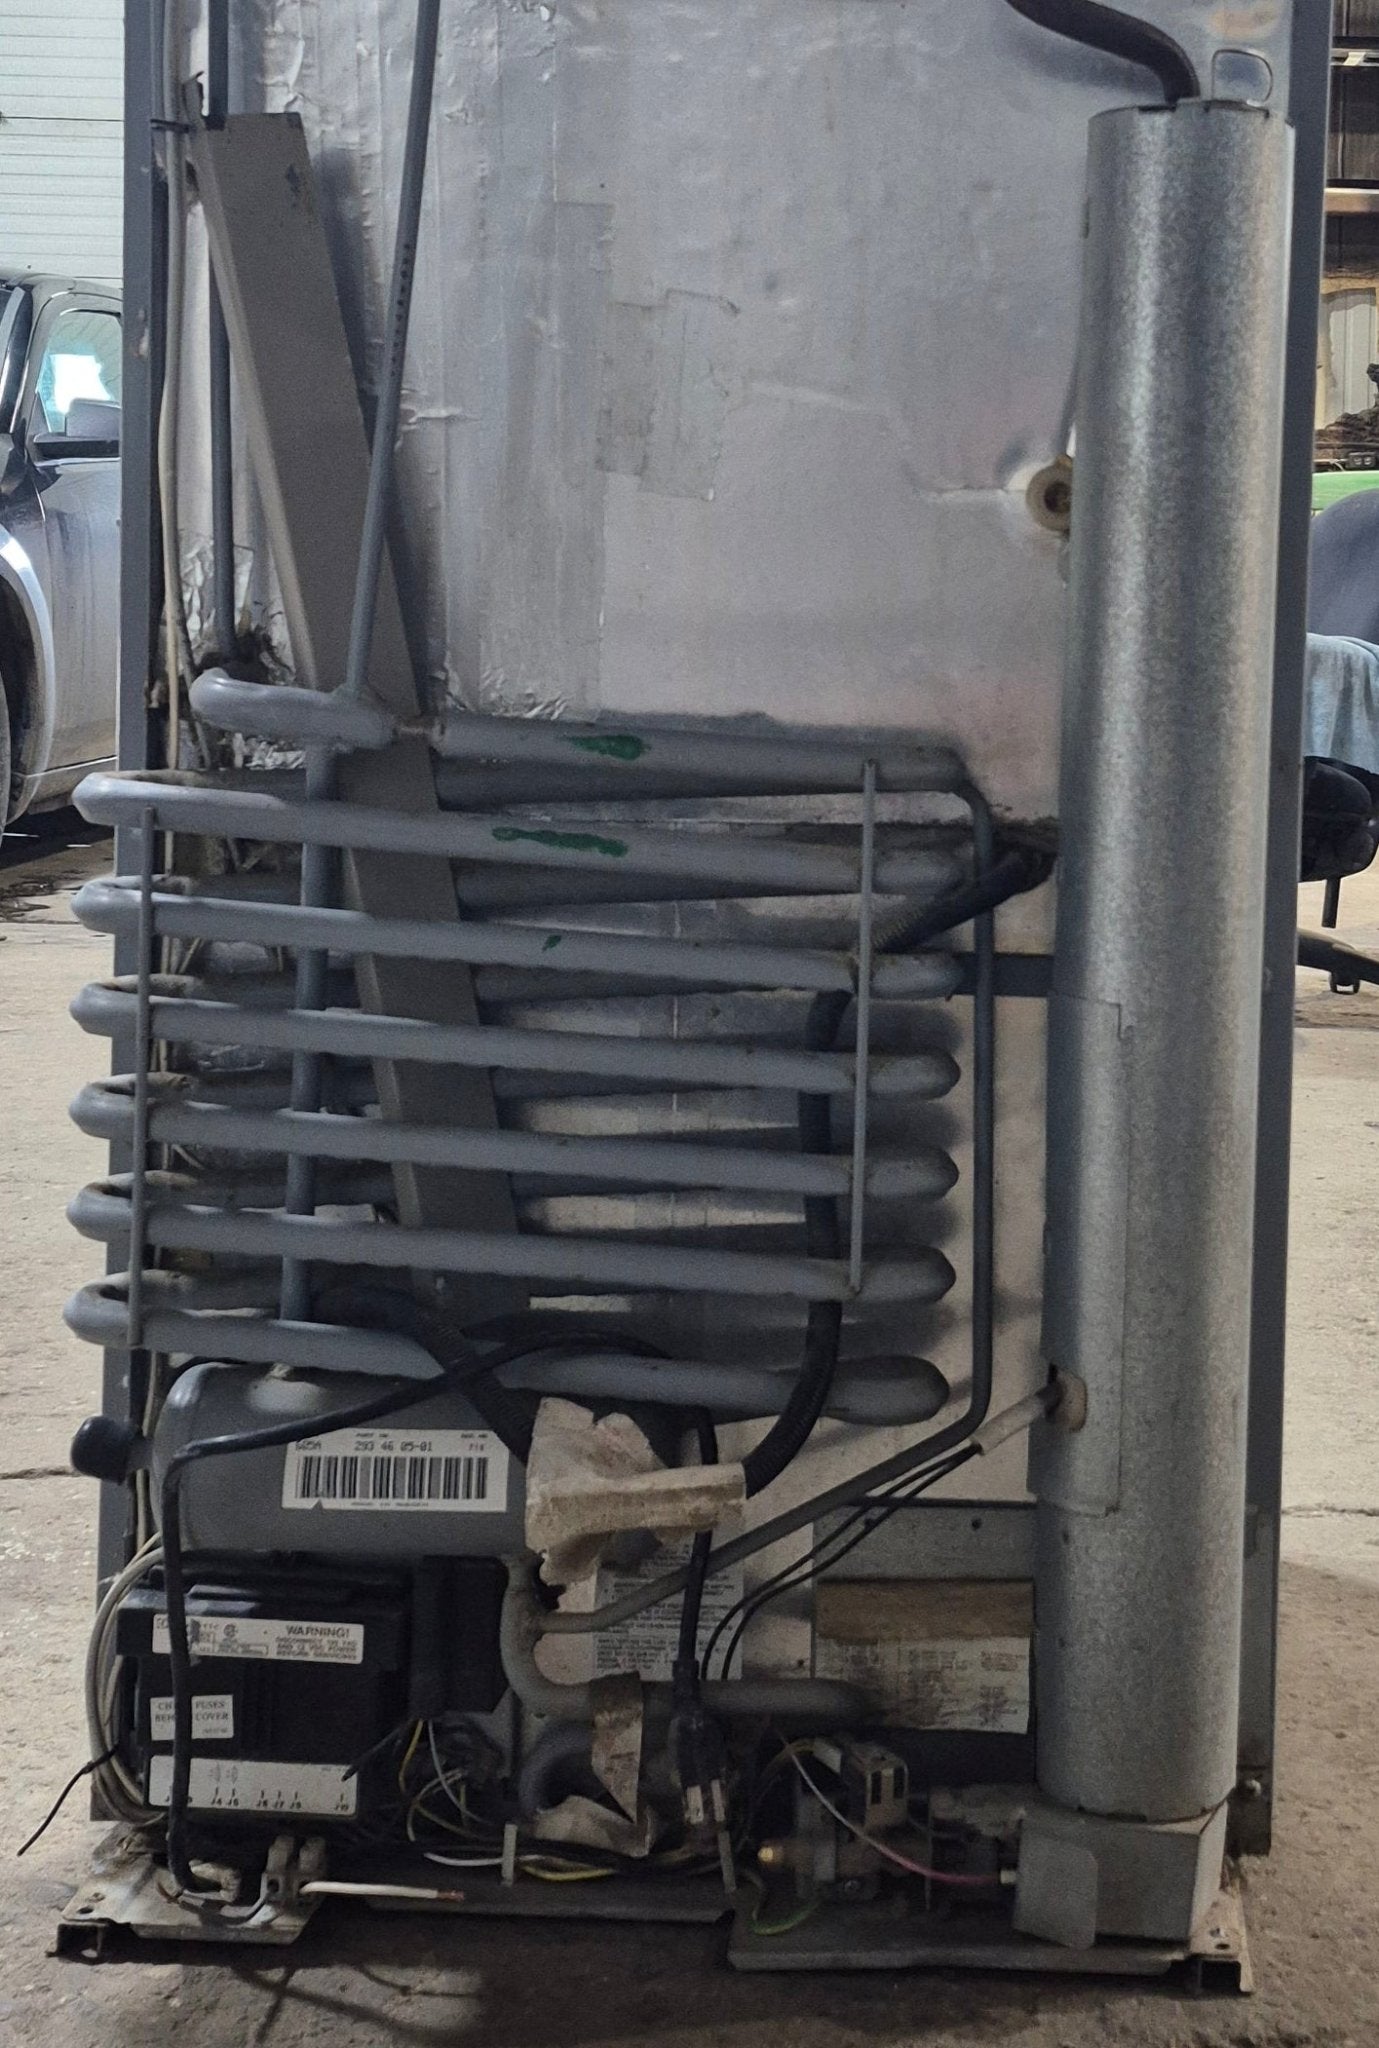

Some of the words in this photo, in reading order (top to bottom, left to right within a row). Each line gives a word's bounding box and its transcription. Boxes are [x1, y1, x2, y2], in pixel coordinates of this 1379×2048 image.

[286, 1625, 350, 1637] WARNING!
[195, 1700, 225, 1709] FUSES
[195, 1712, 229, 1721] COVER
